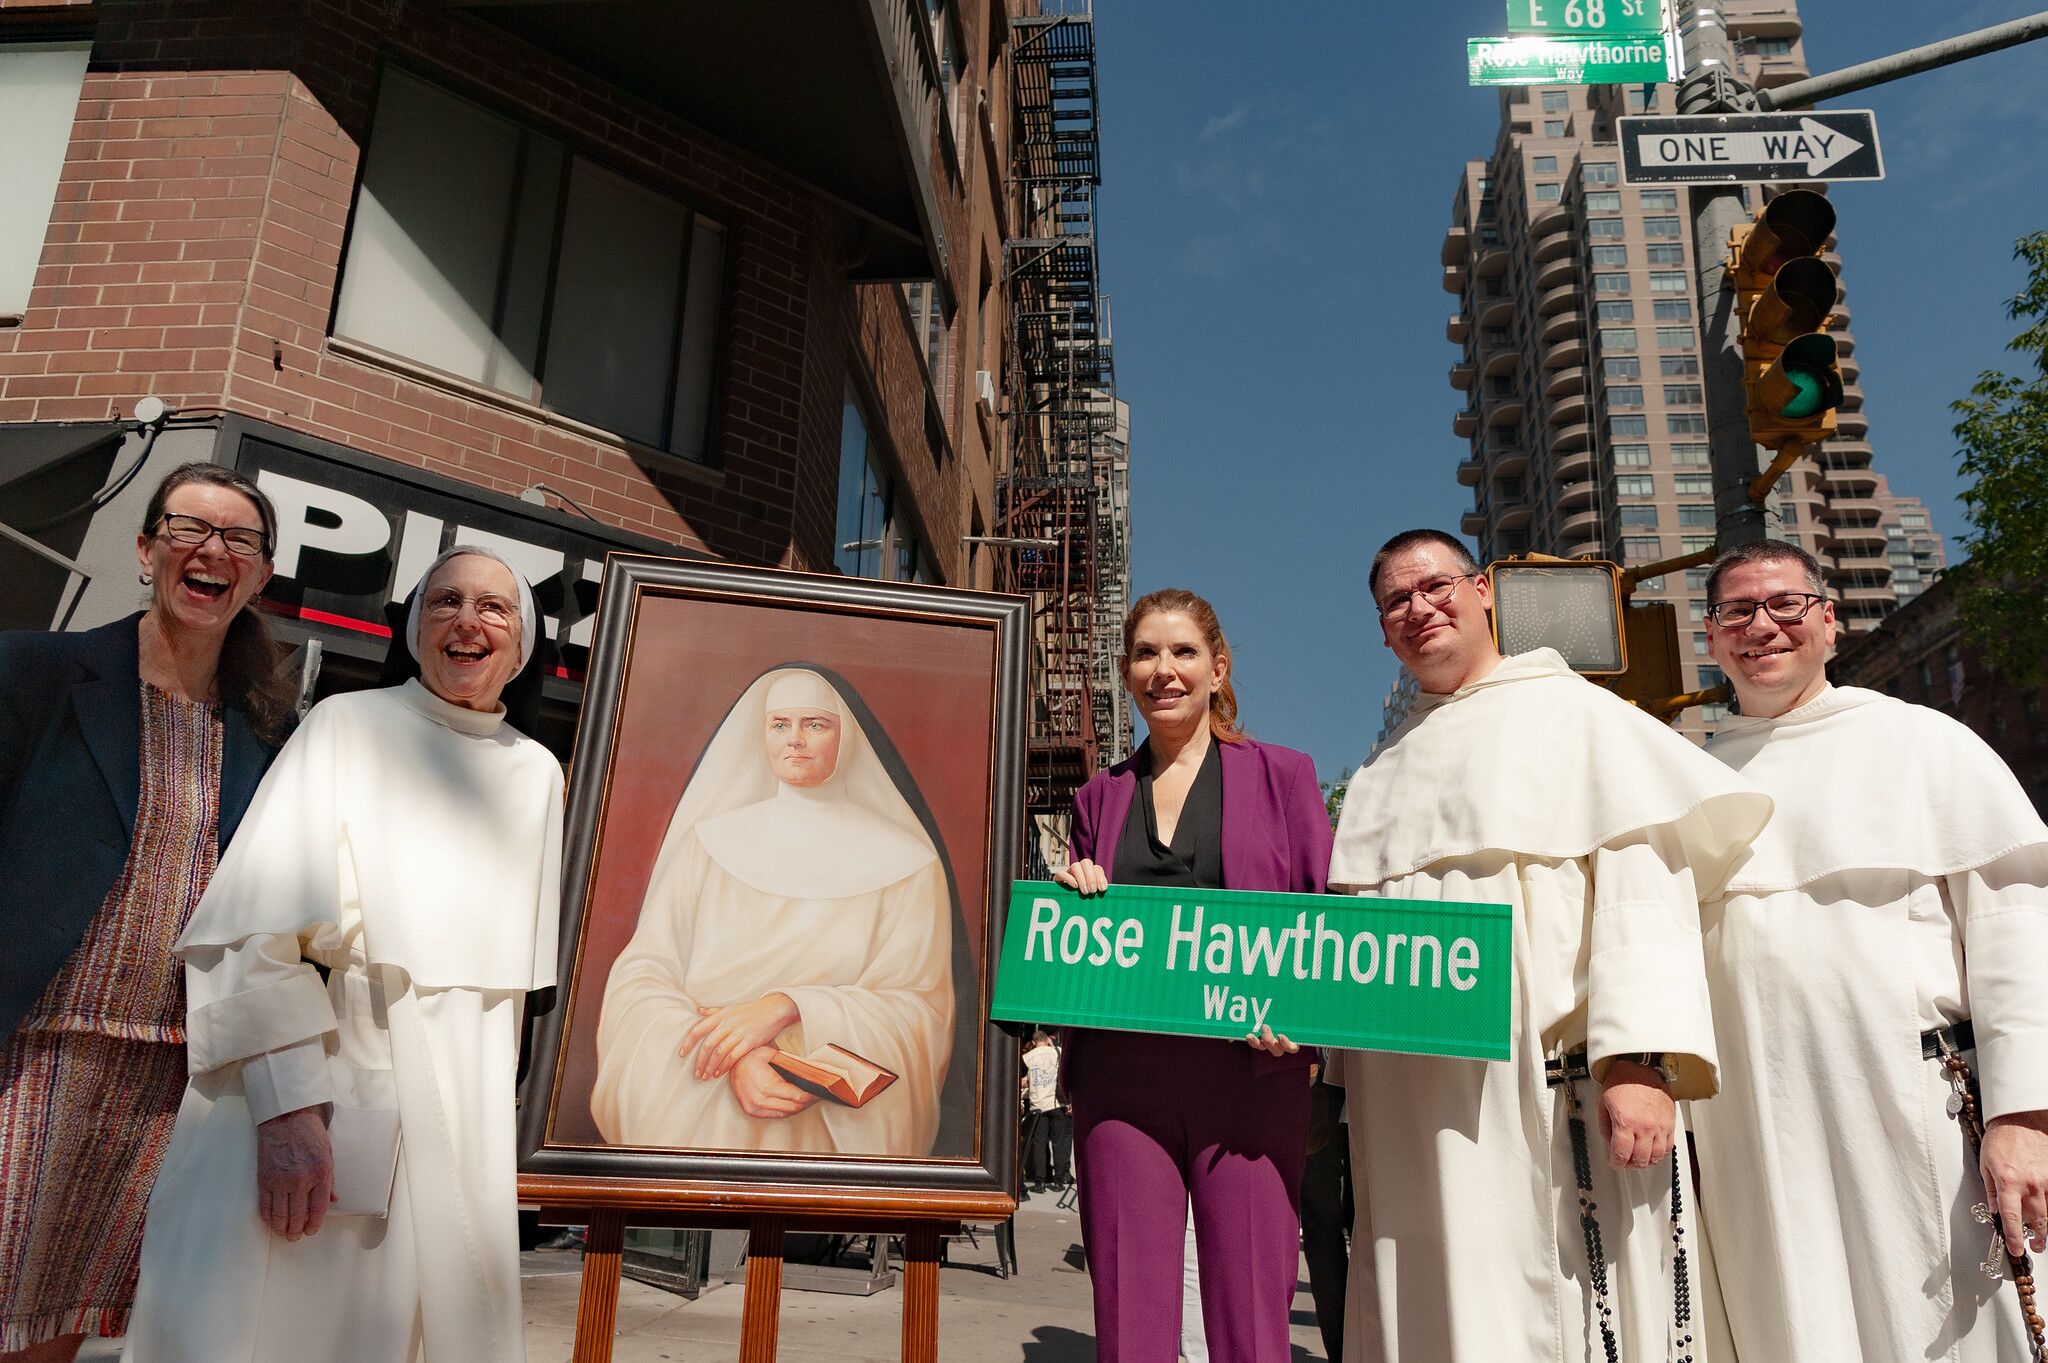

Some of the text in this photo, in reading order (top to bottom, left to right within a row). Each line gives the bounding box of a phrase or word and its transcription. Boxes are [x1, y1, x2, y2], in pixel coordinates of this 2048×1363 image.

[1529, 0, 1645, 28] E 68 St
[1554, 67, 1585, 84] Way
[1659, 134, 1835, 163] ONE WAY
[1024, 897, 1480, 992] Rose Hawthorne
[1203, 984, 1273, 1033] Way
